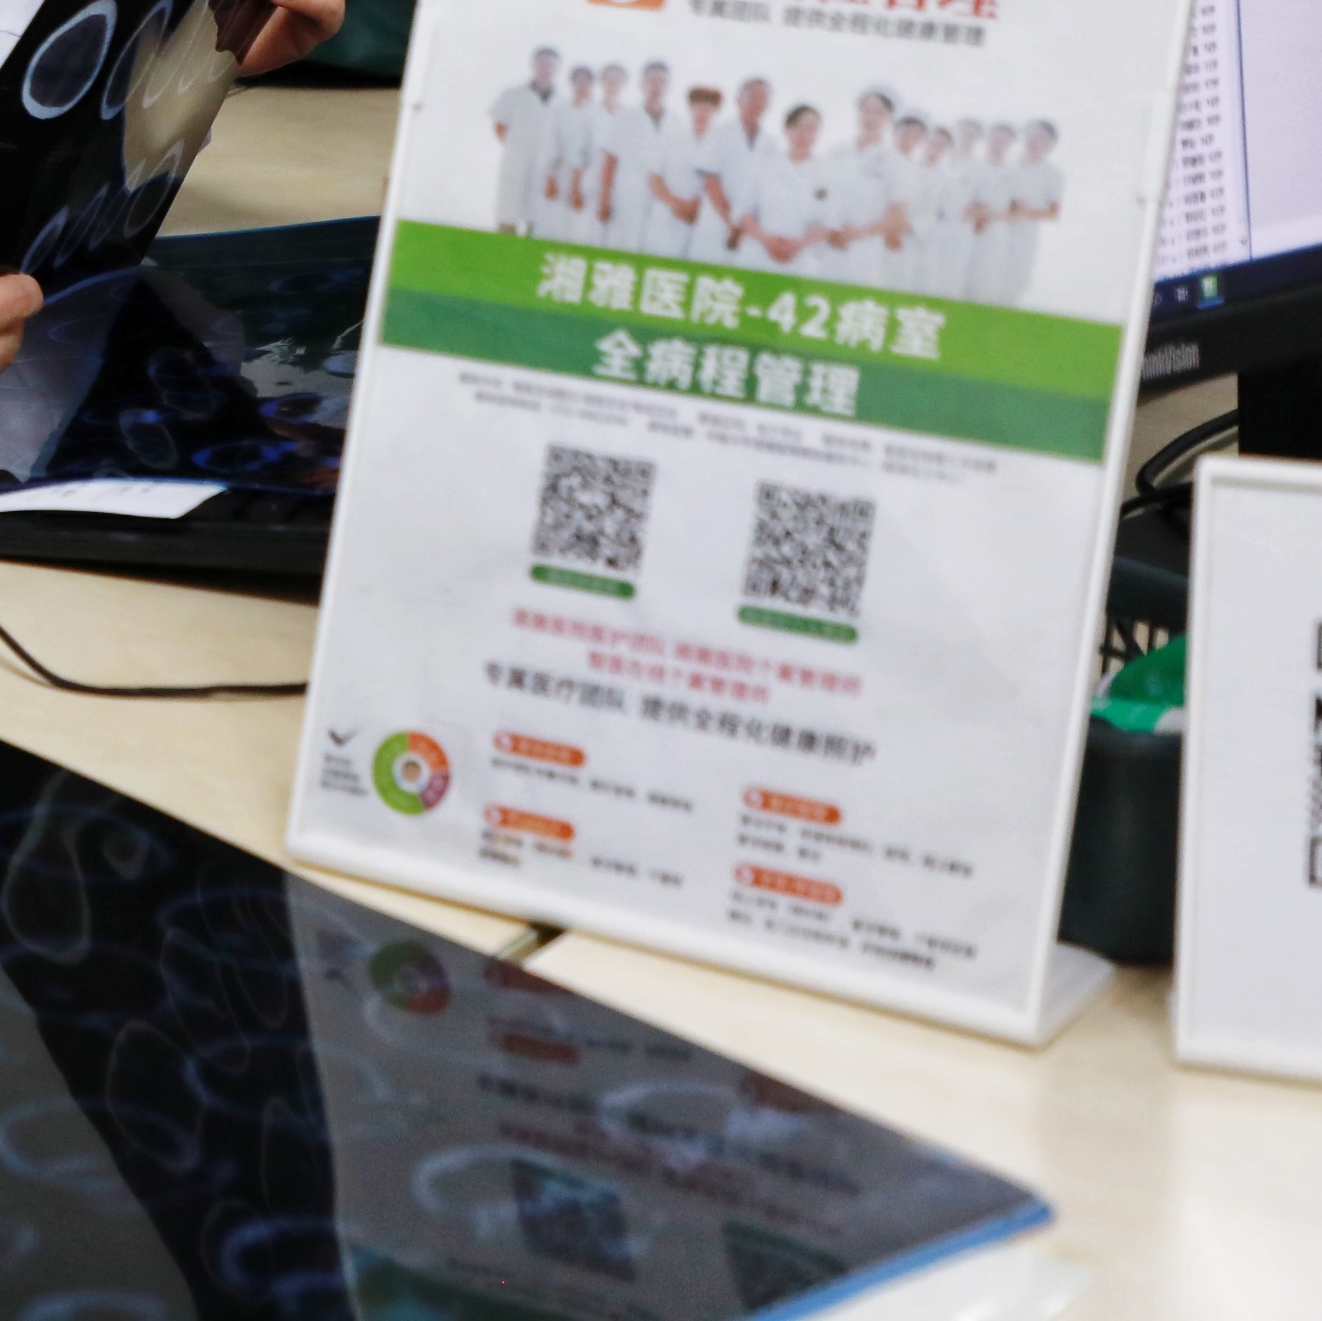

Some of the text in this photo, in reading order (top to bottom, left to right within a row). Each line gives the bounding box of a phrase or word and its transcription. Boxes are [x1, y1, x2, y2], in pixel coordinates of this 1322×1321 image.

[536, 251, 946, 360] 湘雅医院-42病室
[593, 329, 861, 416] 全病程管理
